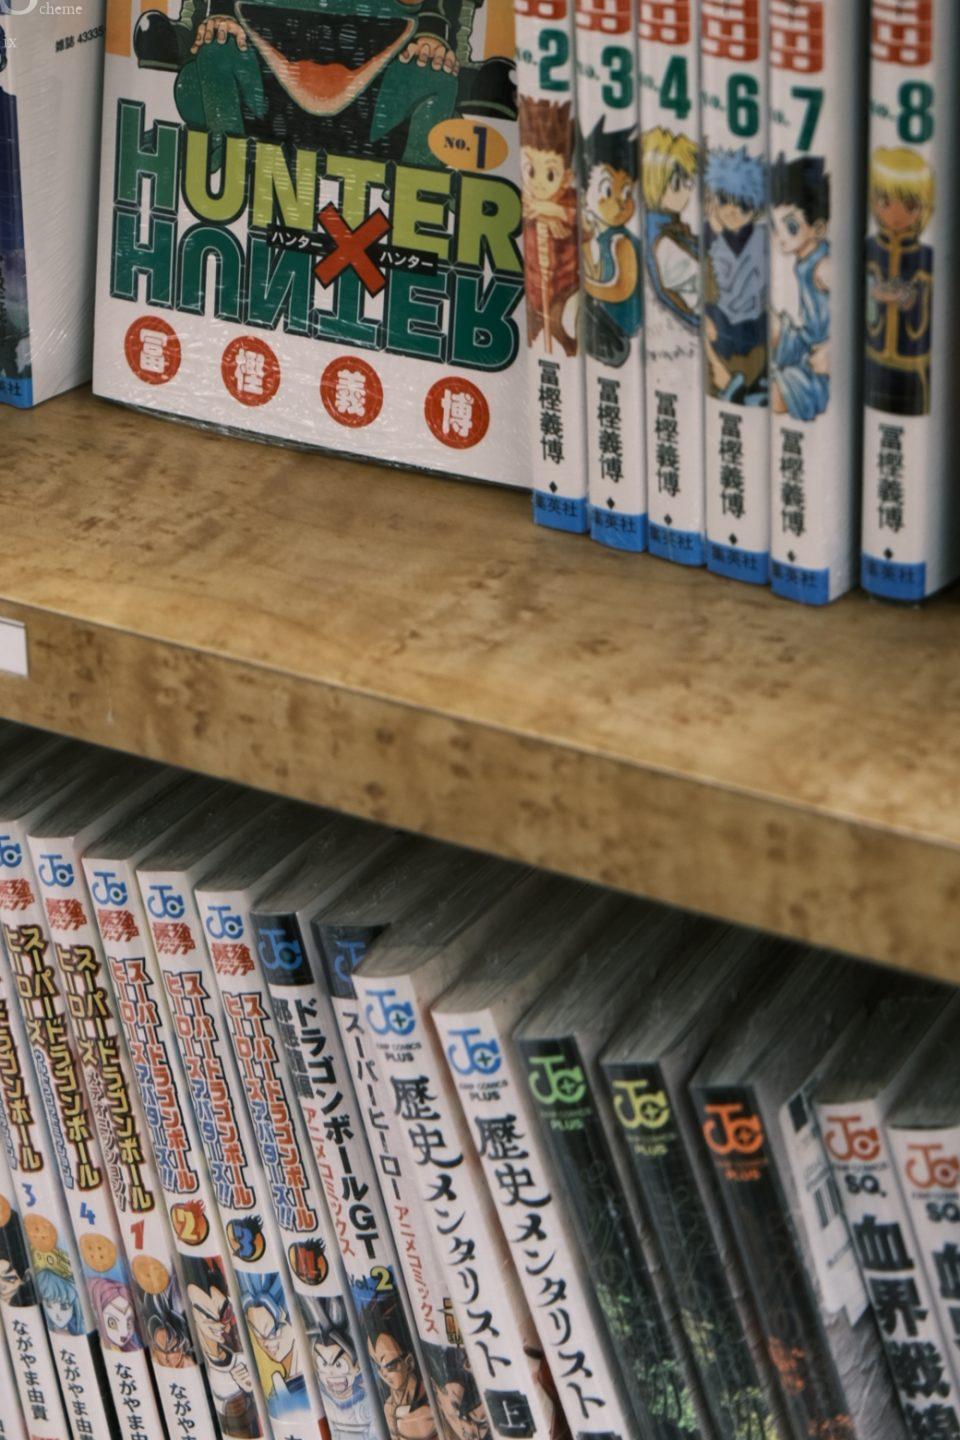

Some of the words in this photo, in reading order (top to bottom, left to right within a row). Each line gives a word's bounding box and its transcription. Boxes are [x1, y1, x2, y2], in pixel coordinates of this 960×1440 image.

[538, 29, 571, 93] 2
[601, 46, 633, 110] 3
[660, 55, 692, 120] 4
[726, 73, 761, 138] 6
[790, 86, 825, 152] 7
[897, 81, 935, 145] 8
[473, 126, 488, 169] 1
[113, 97, 525, 274] HUNTER
[271, 230, 323, 250] ハンター
[380, 251, 434, 270] ハンター
[469, 1089, 502, 1103] PLUS
[295, 998, 381, 1260] ドラゴンボールGT
[79, 1200, 96, 1226] 4
[130, 1219, 145, 1250] 1
[176, 1208, 200, 1240] 2
[390, 1074, 512, 1379] 歴史メンタリスト
[370, 1266, 395, 1292] 2
[474, 1113, 607, 1421] 歴史メンタリスト
